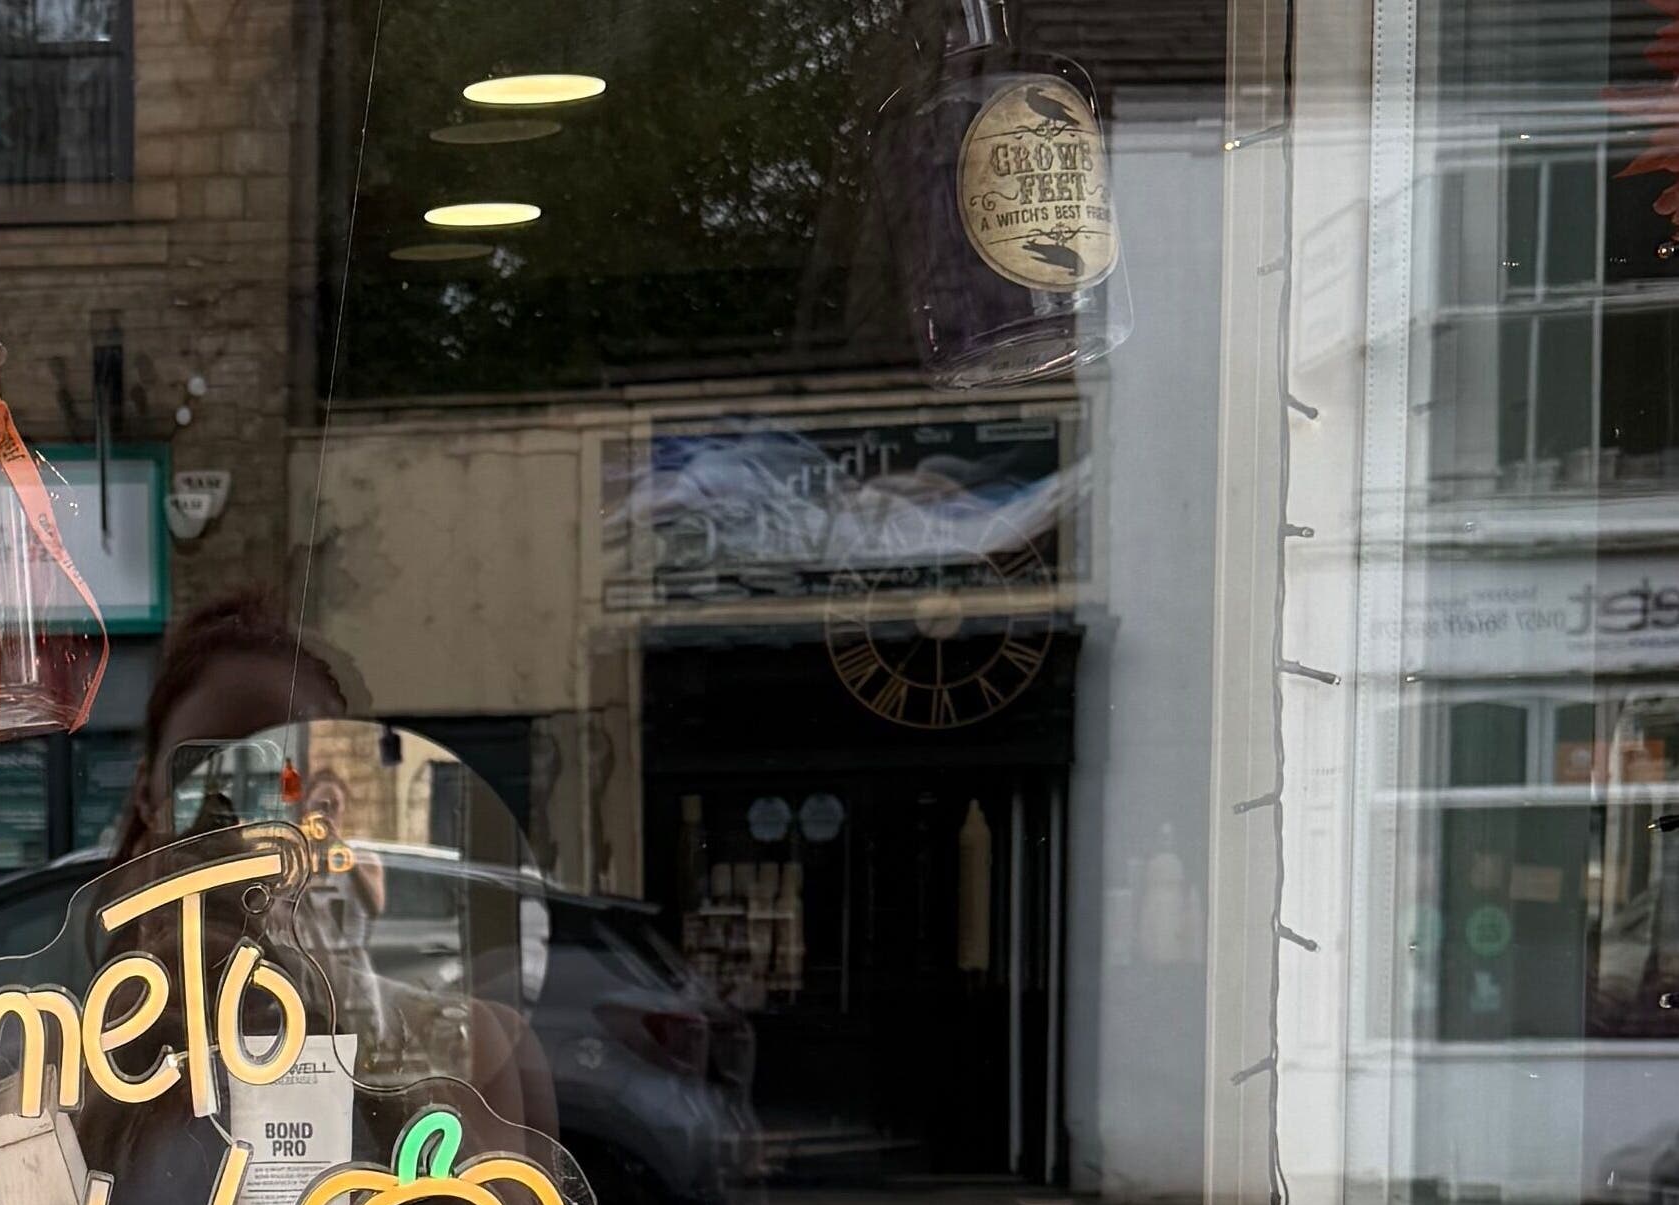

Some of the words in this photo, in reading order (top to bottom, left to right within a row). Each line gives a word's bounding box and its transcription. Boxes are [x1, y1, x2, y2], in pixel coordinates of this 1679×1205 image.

[1015, 172, 1087, 205] FEET
[981, 218, 990, 231] A
[997, 208, 1049, 228] WITCH'S
[1055, 205, 1082, 220] BEST
[265, 1122, 314, 1139] BOND
[272, 1139, 307, 1157] PRO
